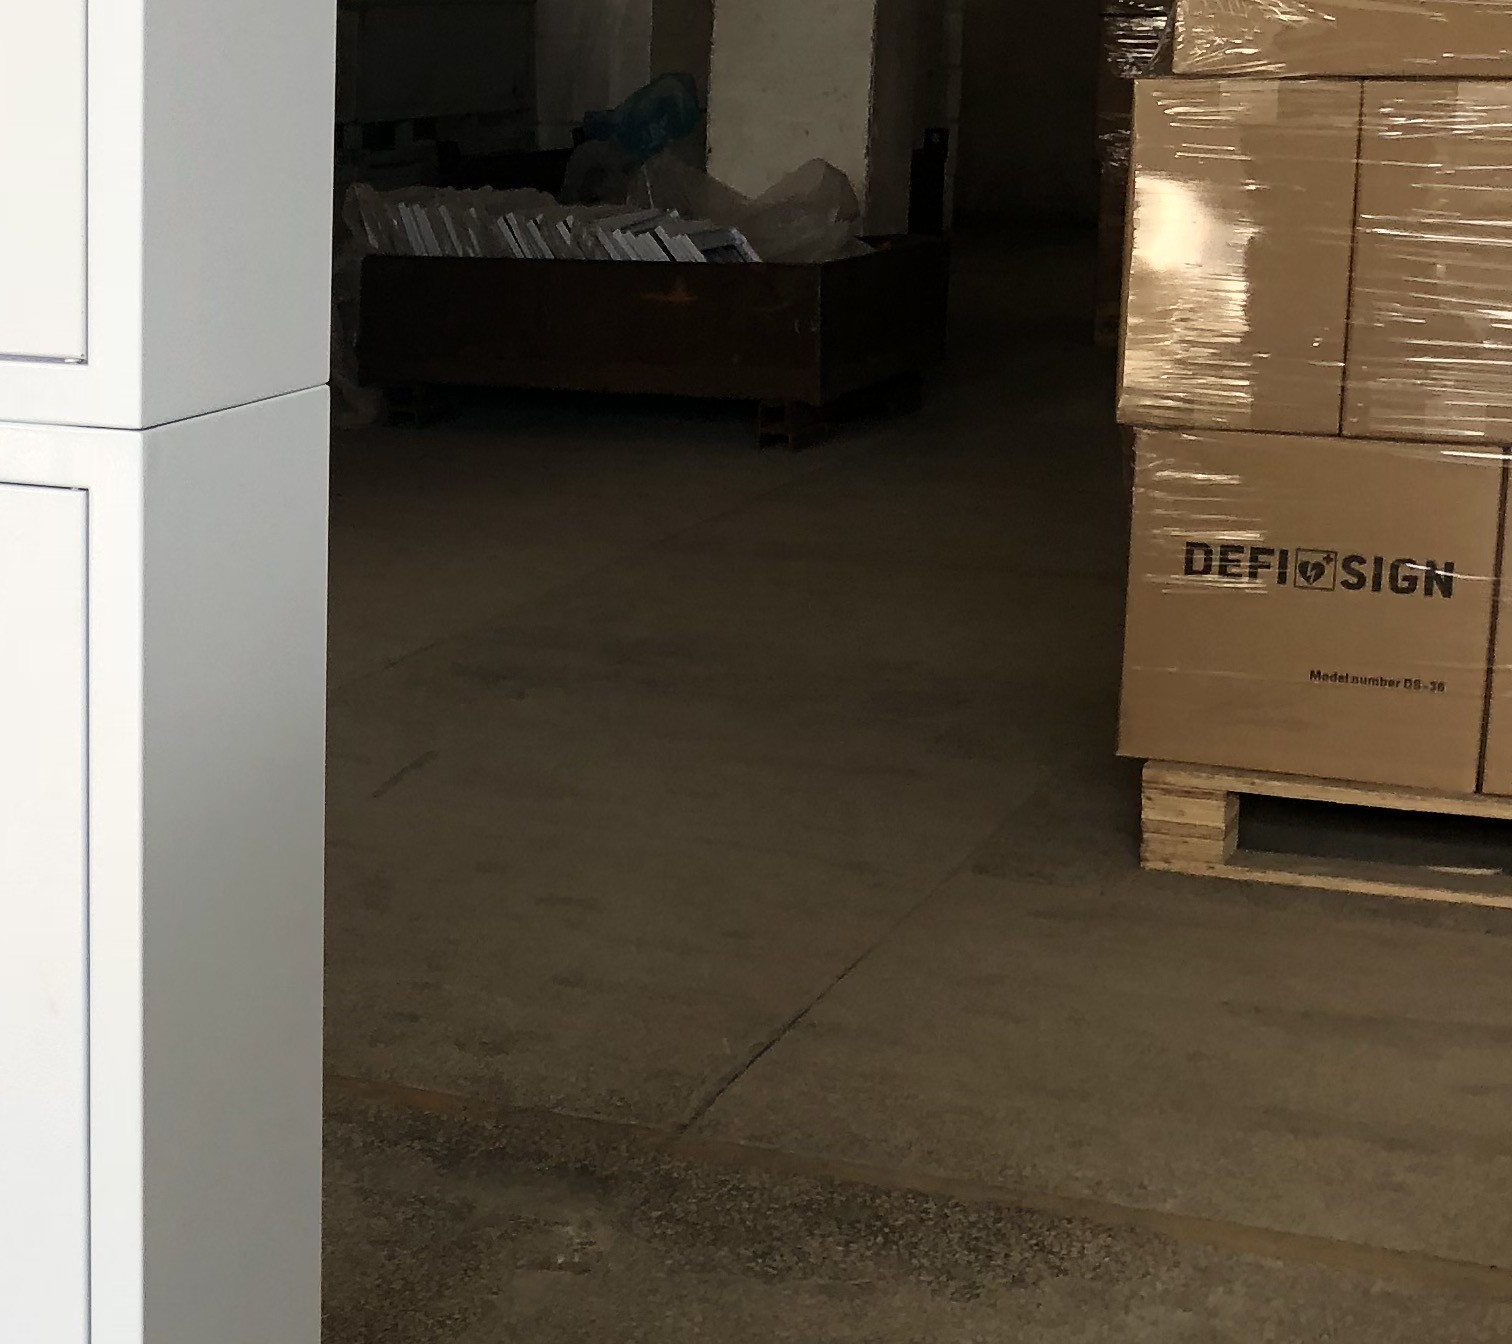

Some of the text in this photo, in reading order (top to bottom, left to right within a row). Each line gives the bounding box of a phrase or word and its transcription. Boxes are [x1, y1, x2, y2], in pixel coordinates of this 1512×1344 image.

[1184, 541, 1455, 599] DEFI SIGN
[1309, 670, 1349, 683] Model
[1351, 676, 1401, 688] number
